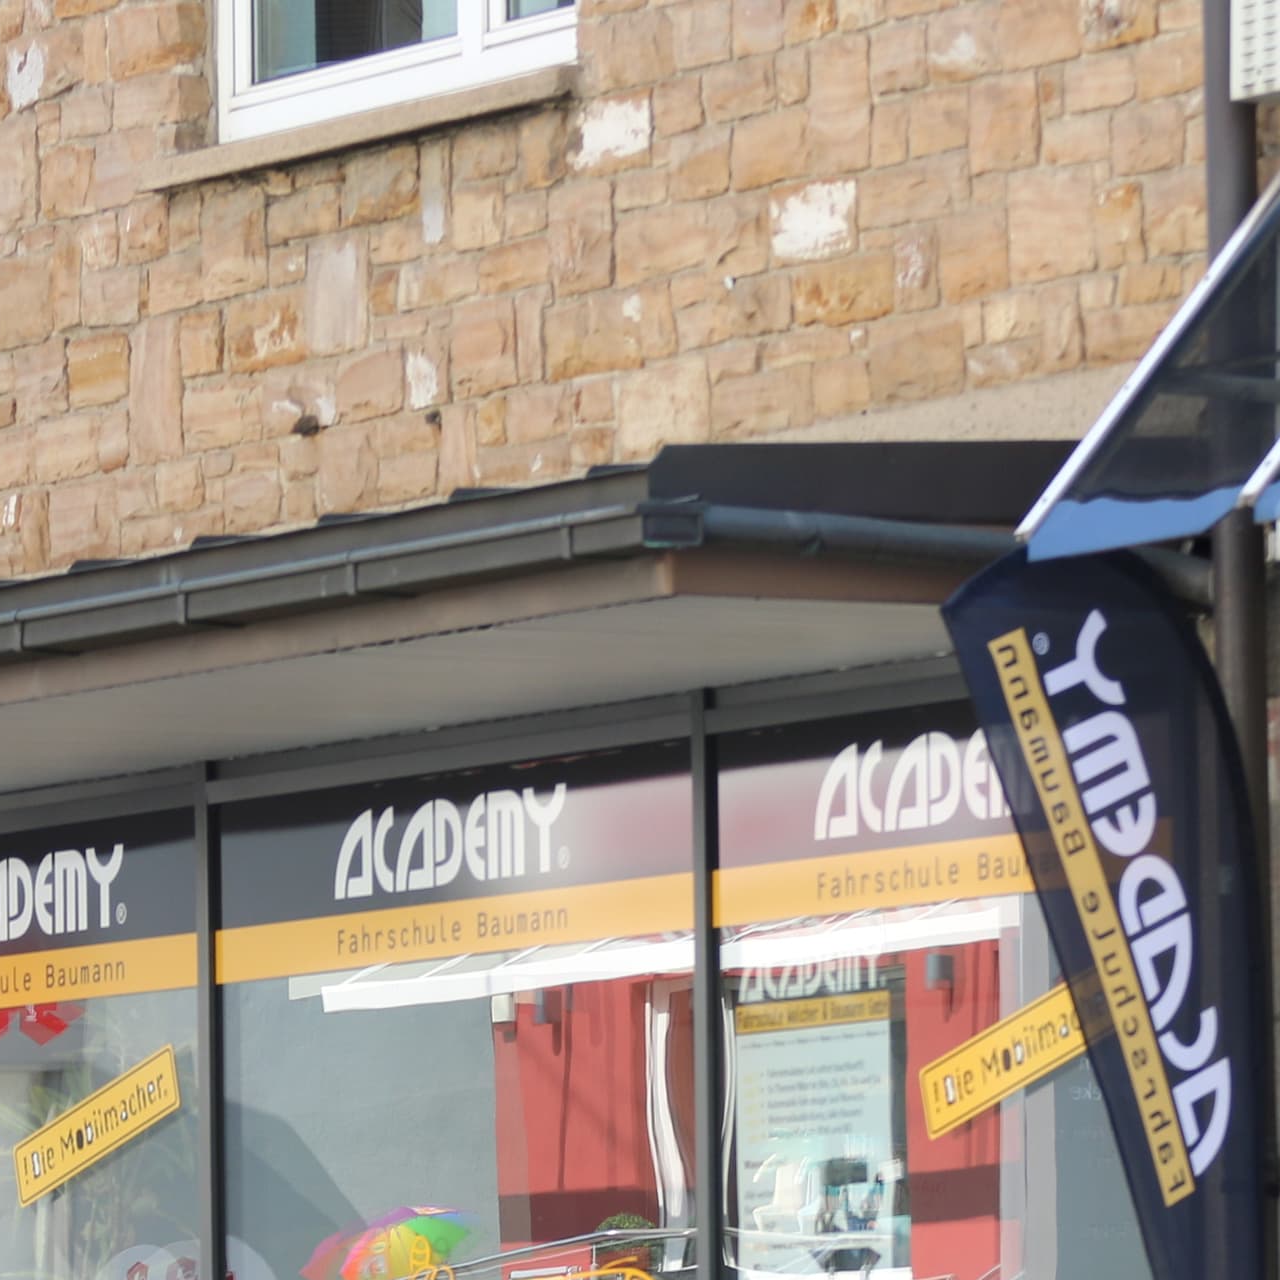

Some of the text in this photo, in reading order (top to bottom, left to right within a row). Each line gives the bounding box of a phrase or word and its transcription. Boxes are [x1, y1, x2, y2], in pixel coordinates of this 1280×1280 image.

[818, 857, 959, 900] Fahrschule
[337, 907, 568, 956] Fahrschule Baumann
[45, 960, 125, 989] Baumann
